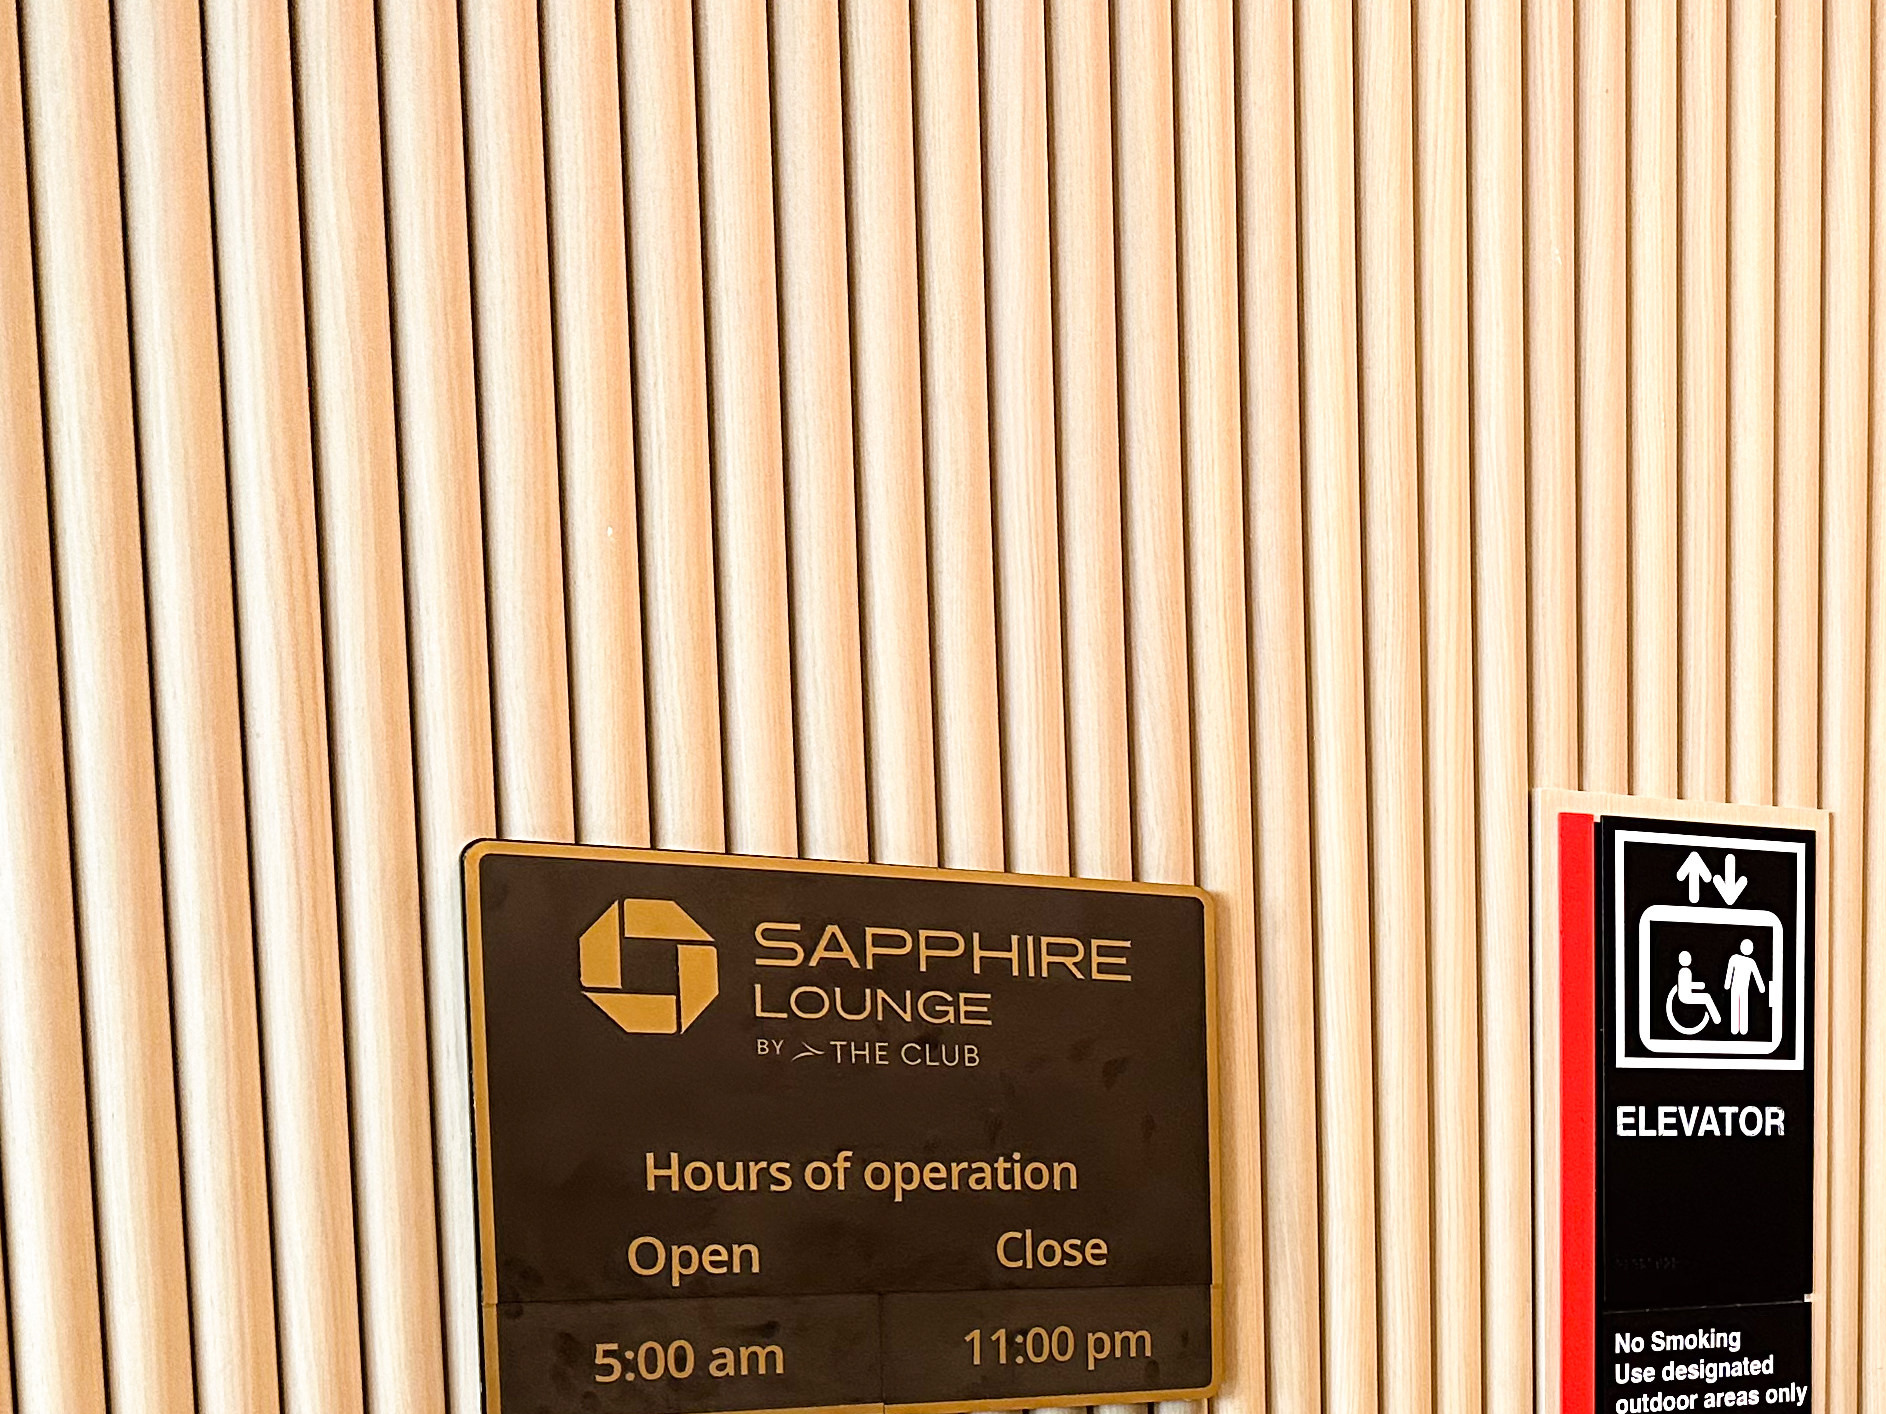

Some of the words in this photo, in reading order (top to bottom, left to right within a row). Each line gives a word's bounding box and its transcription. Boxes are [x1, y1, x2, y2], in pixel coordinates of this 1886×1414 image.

[754, 921, 1132, 981] SAPPHIRE
[754, 983, 993, 1026] LOUNGE
[756, 1038, 784, 1055] BY
[830, 1040, 890, 1065] THE
[901, 1043, 980, 1067] CLUB
[1616, 1105, 1785, 1136] ELEVATOR
[645, 1151, 792, 1192] Hours
[804, 1150, 853, 1191] of
[864, 1151, 1078, 1202] operation
[627, 1235, 760, 1287] Open
[996, 1229, 1108, 1269] Close
[594, 1339, 695, 1383] 5:00
[708, 1342, 785, 1378] am
[964, 1325, 1074, 1366] 11:00
[1086, 1327, 1153, 1370] pm
[1615, 1332, 1645, 1354] No
[1651, 1328, 1741, 1353] Smoking
[1615, 1363, 1656, 1385] Use
[1661, 1354, 1774, 1384] designated
[1615, 1391, 1698, 1414] outdoor
[1703, 1388, 1760, 1409] areas
[1765, 1382, 1808, 1407] only
